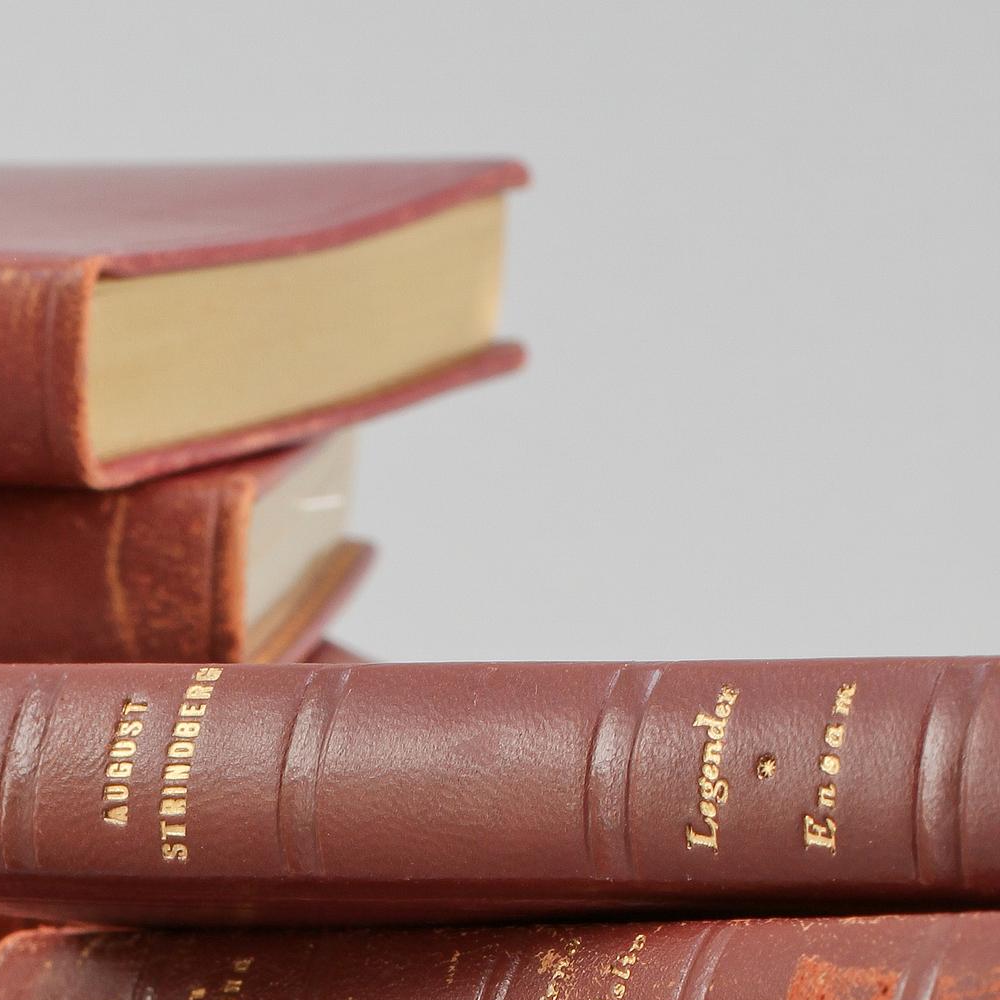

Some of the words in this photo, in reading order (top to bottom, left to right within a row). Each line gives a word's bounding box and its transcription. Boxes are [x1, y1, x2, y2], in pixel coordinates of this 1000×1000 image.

[103, 700, 148, 826] AUGUST
[159, 667, 223, 864] STRINDBERG
[685, 684, 740, 855] Legender
[804, 682, 857, 856] Ensam
